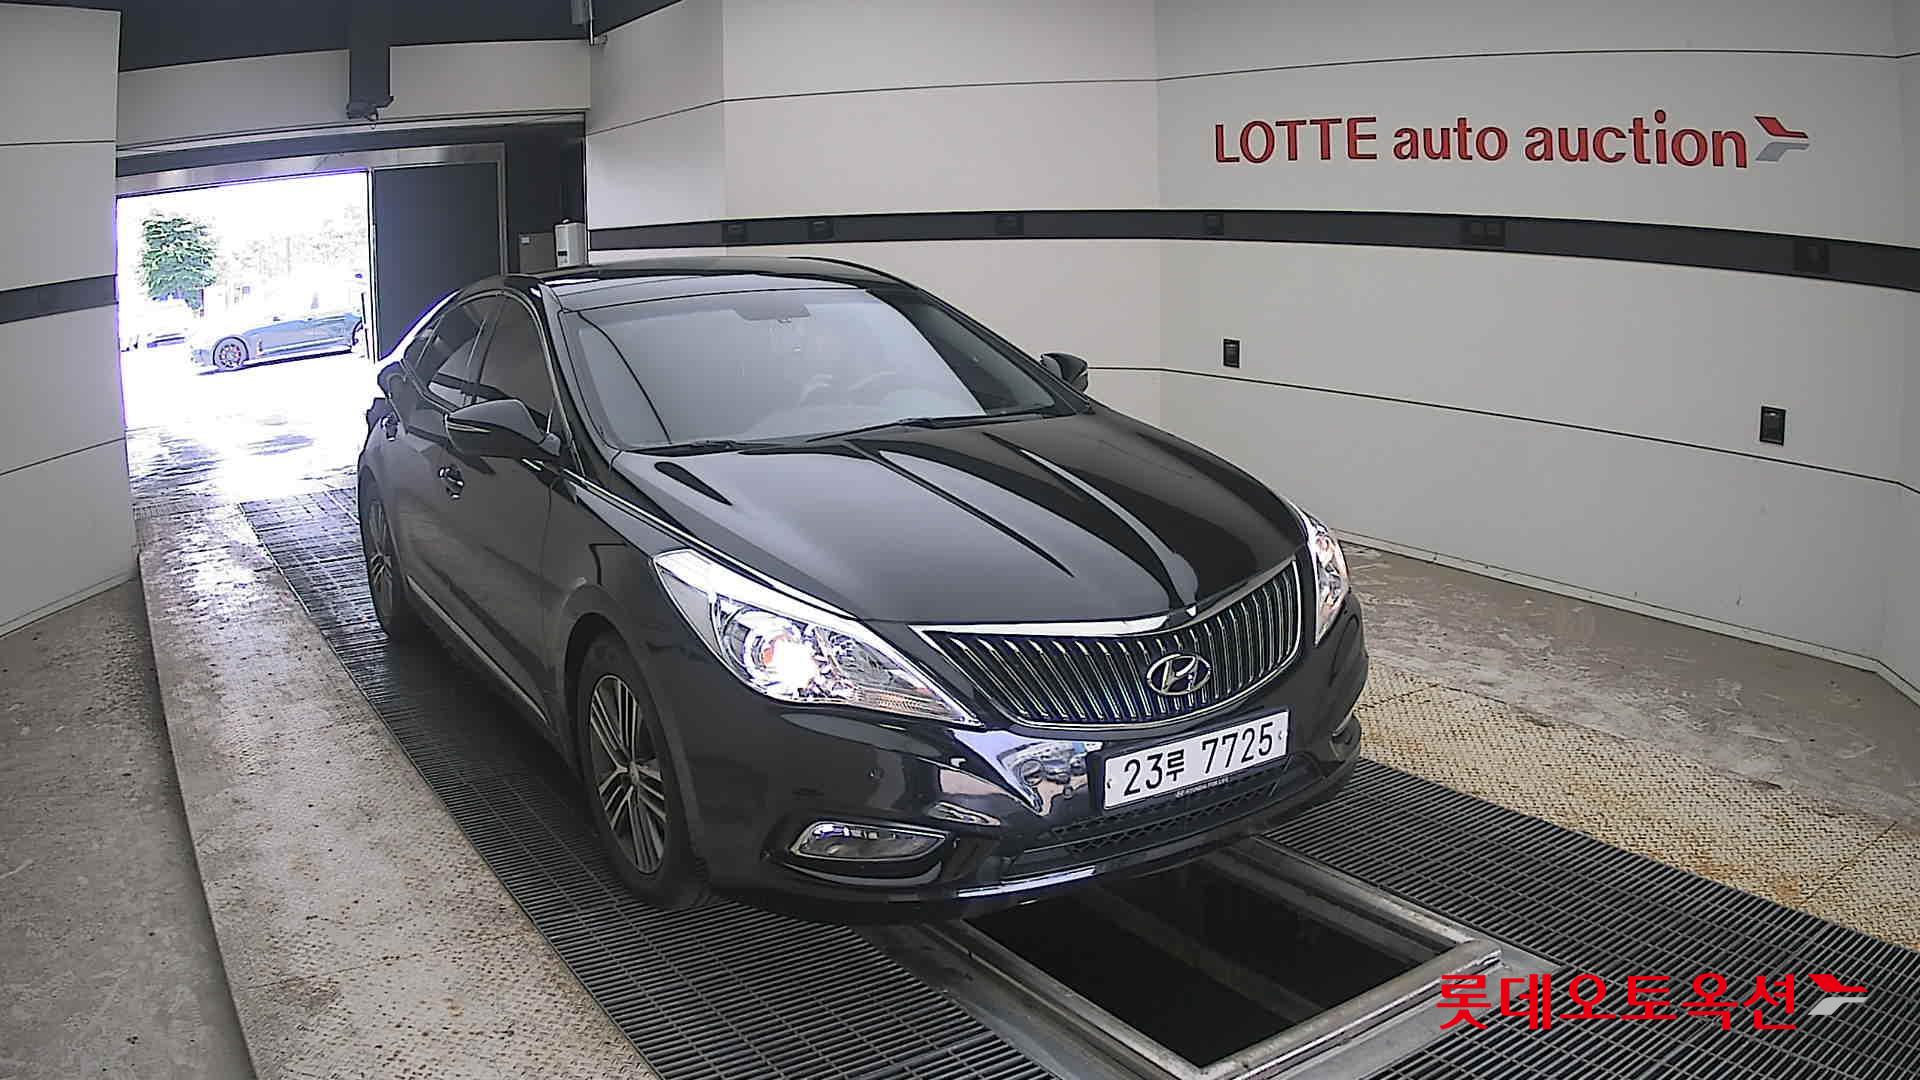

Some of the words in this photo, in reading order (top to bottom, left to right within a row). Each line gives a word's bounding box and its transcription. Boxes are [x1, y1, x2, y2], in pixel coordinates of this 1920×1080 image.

[1215, 117, 1377, 163] LOTTE
[1393, 118, 1508, 161] auto
[1524, 110, 1747, 168] auction
[1123, 749, 1185, 796] 23루
[1202, 722, 1273, 774] 7725
